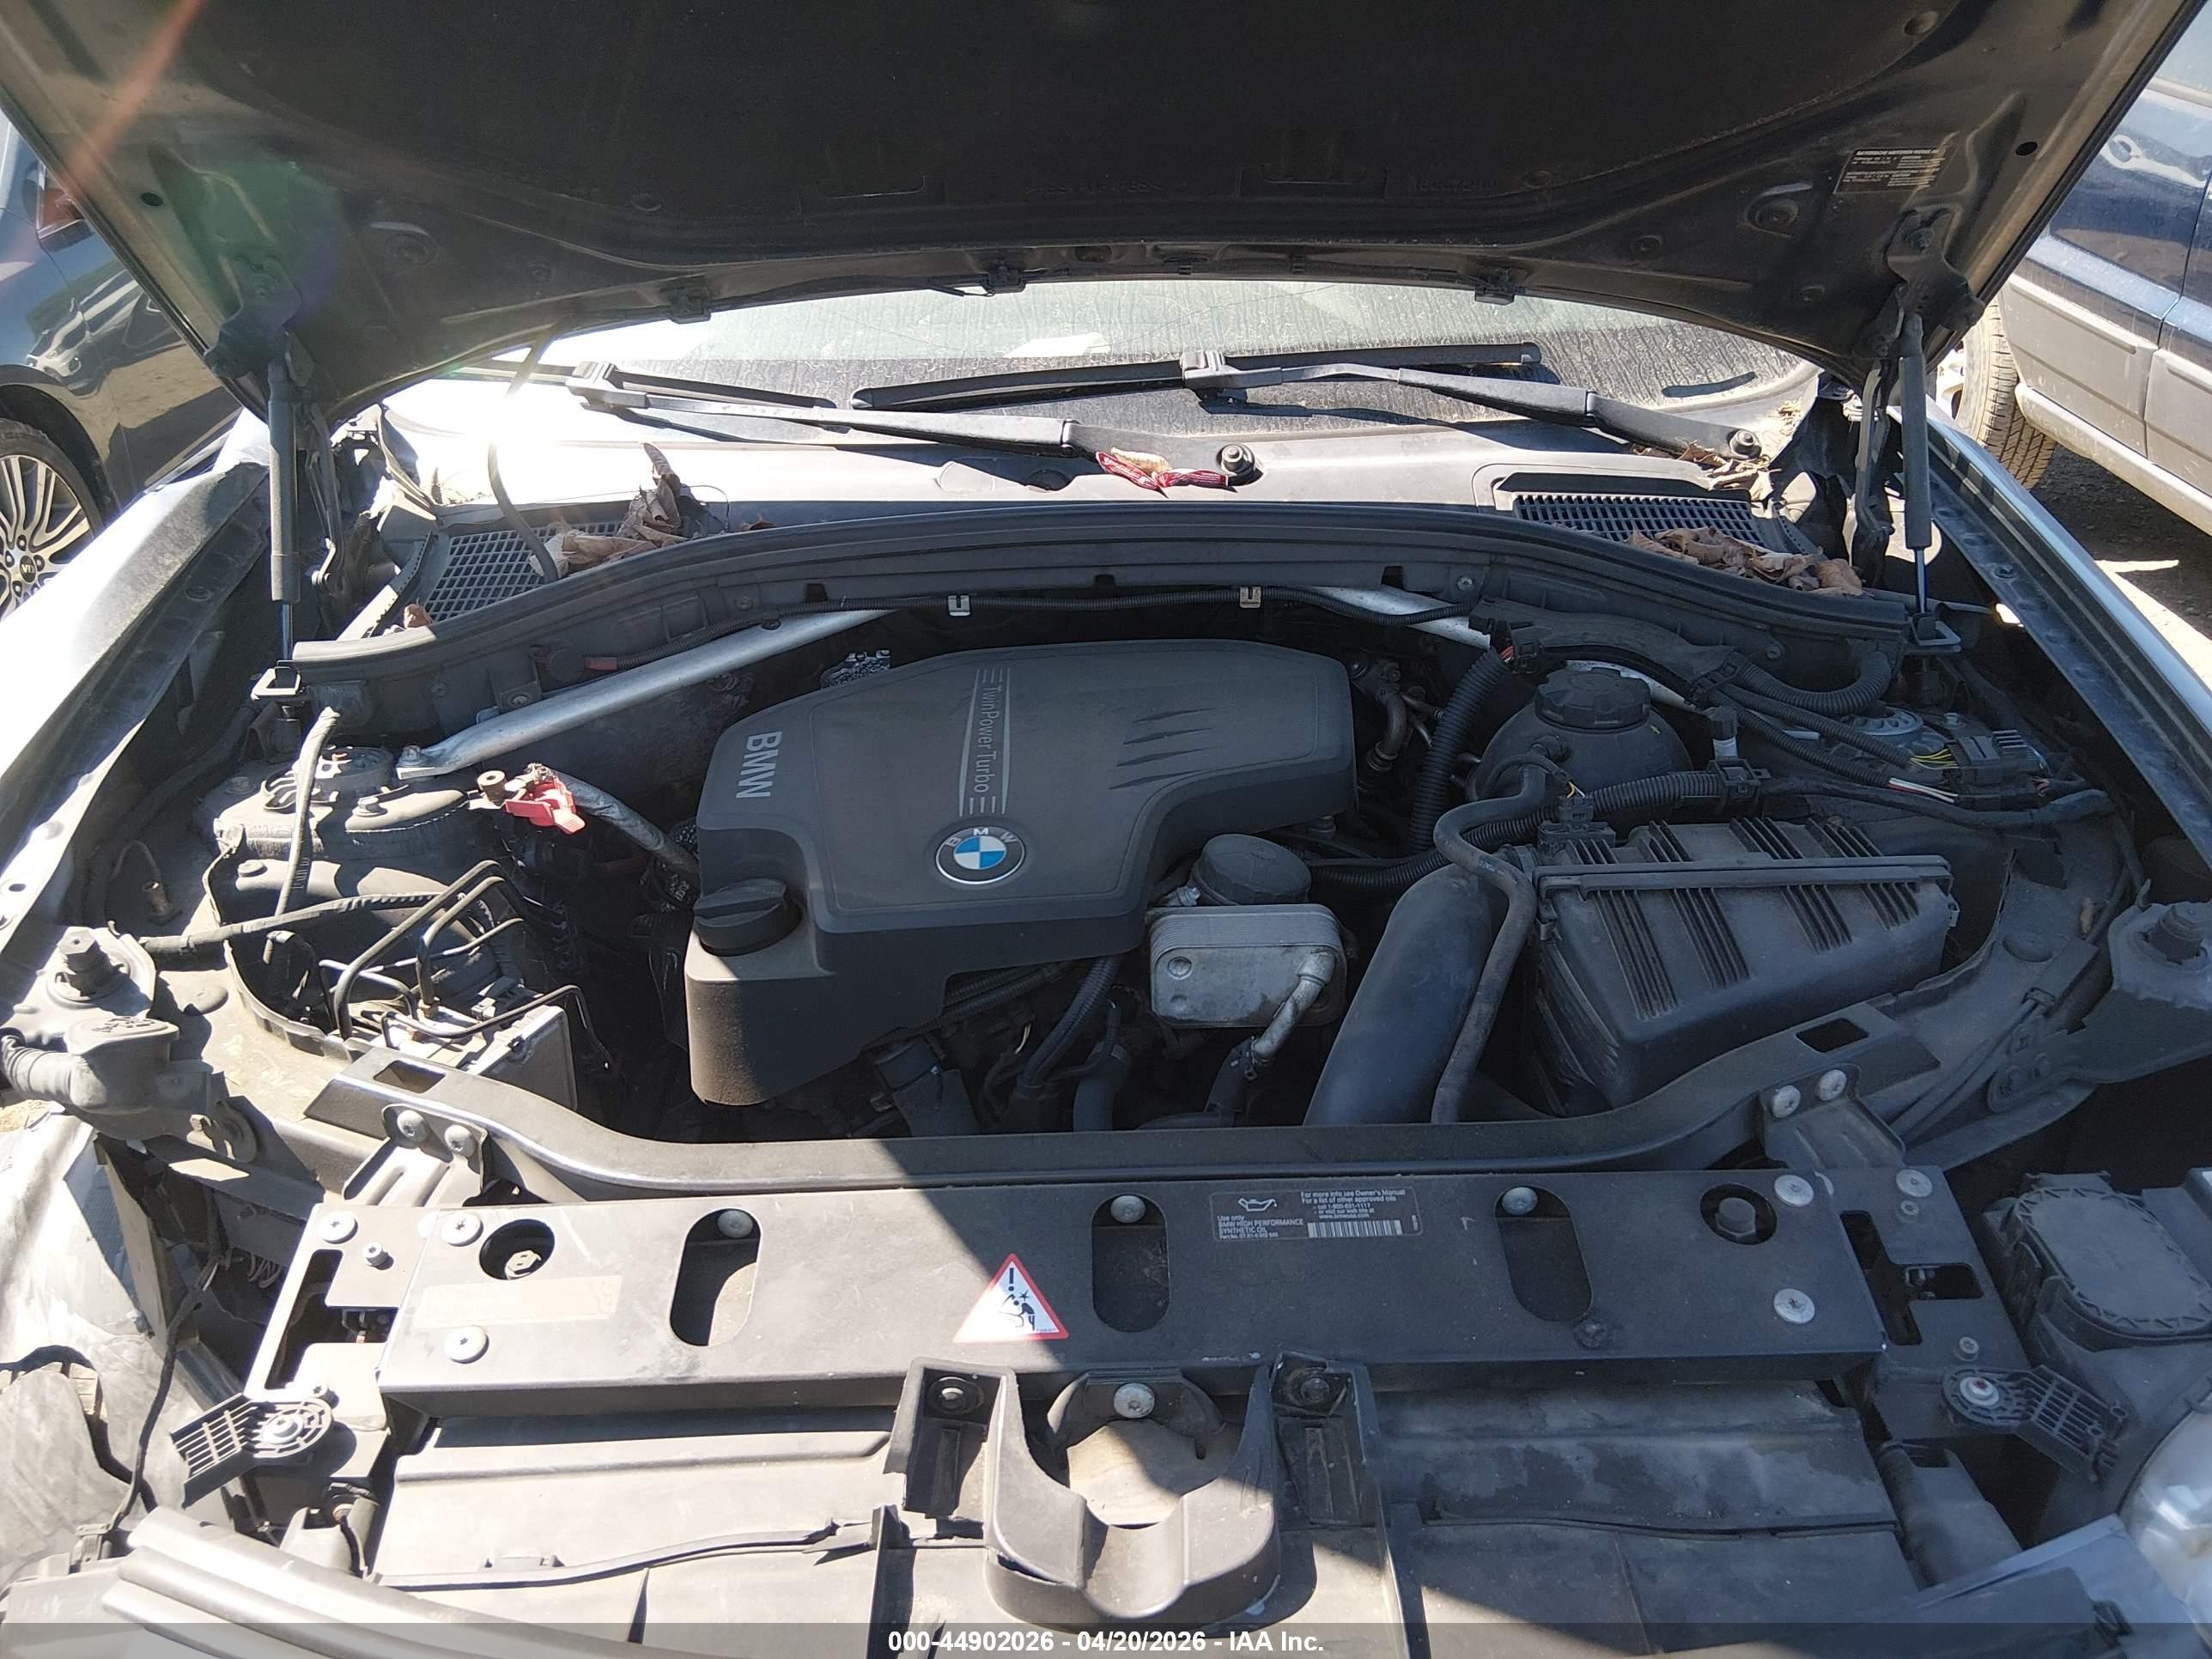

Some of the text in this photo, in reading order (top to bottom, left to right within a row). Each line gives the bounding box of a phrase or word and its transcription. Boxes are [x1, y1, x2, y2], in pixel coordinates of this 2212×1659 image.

[973, 685, 998, 793] TwinPower Turbo
[736, 731, 782, 799] BMW
[945, 827, 1017, 848] BMW
[1231, 1215, 1245, 1223] only
[1254, 1218, 1304, 1226] PERFORMANCE
